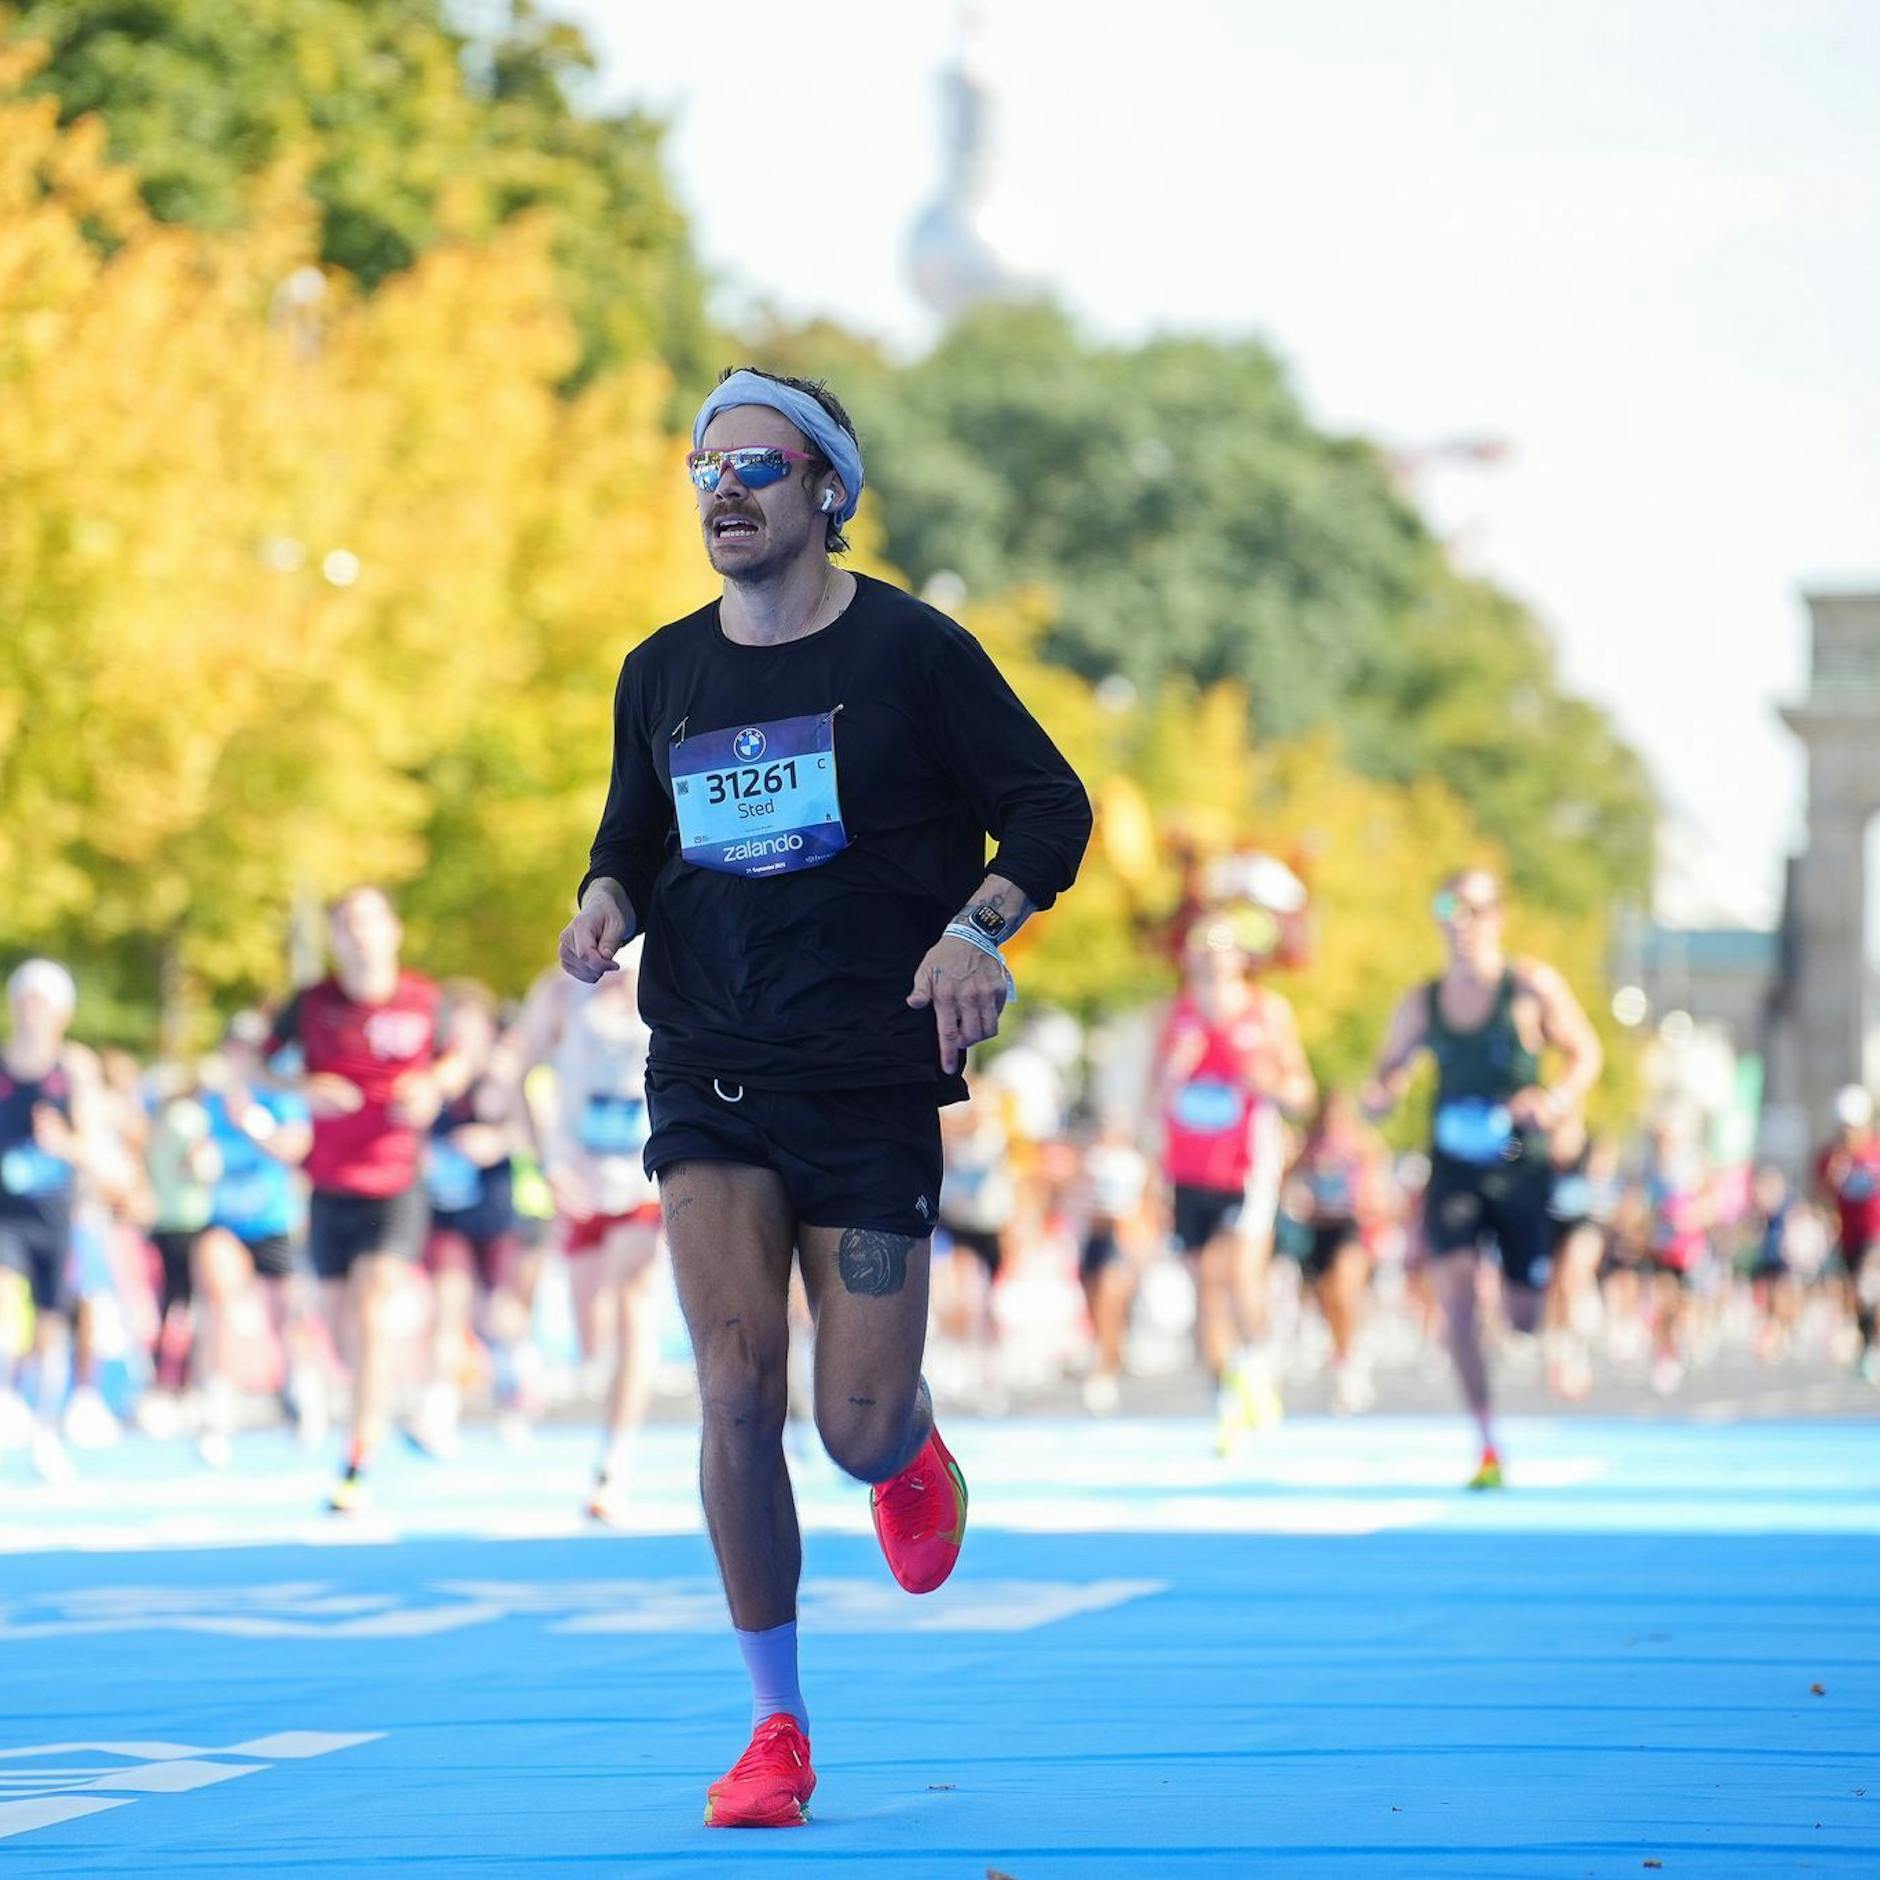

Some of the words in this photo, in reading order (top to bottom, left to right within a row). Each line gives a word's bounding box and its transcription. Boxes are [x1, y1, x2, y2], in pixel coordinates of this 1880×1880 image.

[817, 758, 826, 769] C
[706, 760, 798, 805] 31261
[737, 799, 775, 819] Sted
[723, 834, 803, 862] zalando
